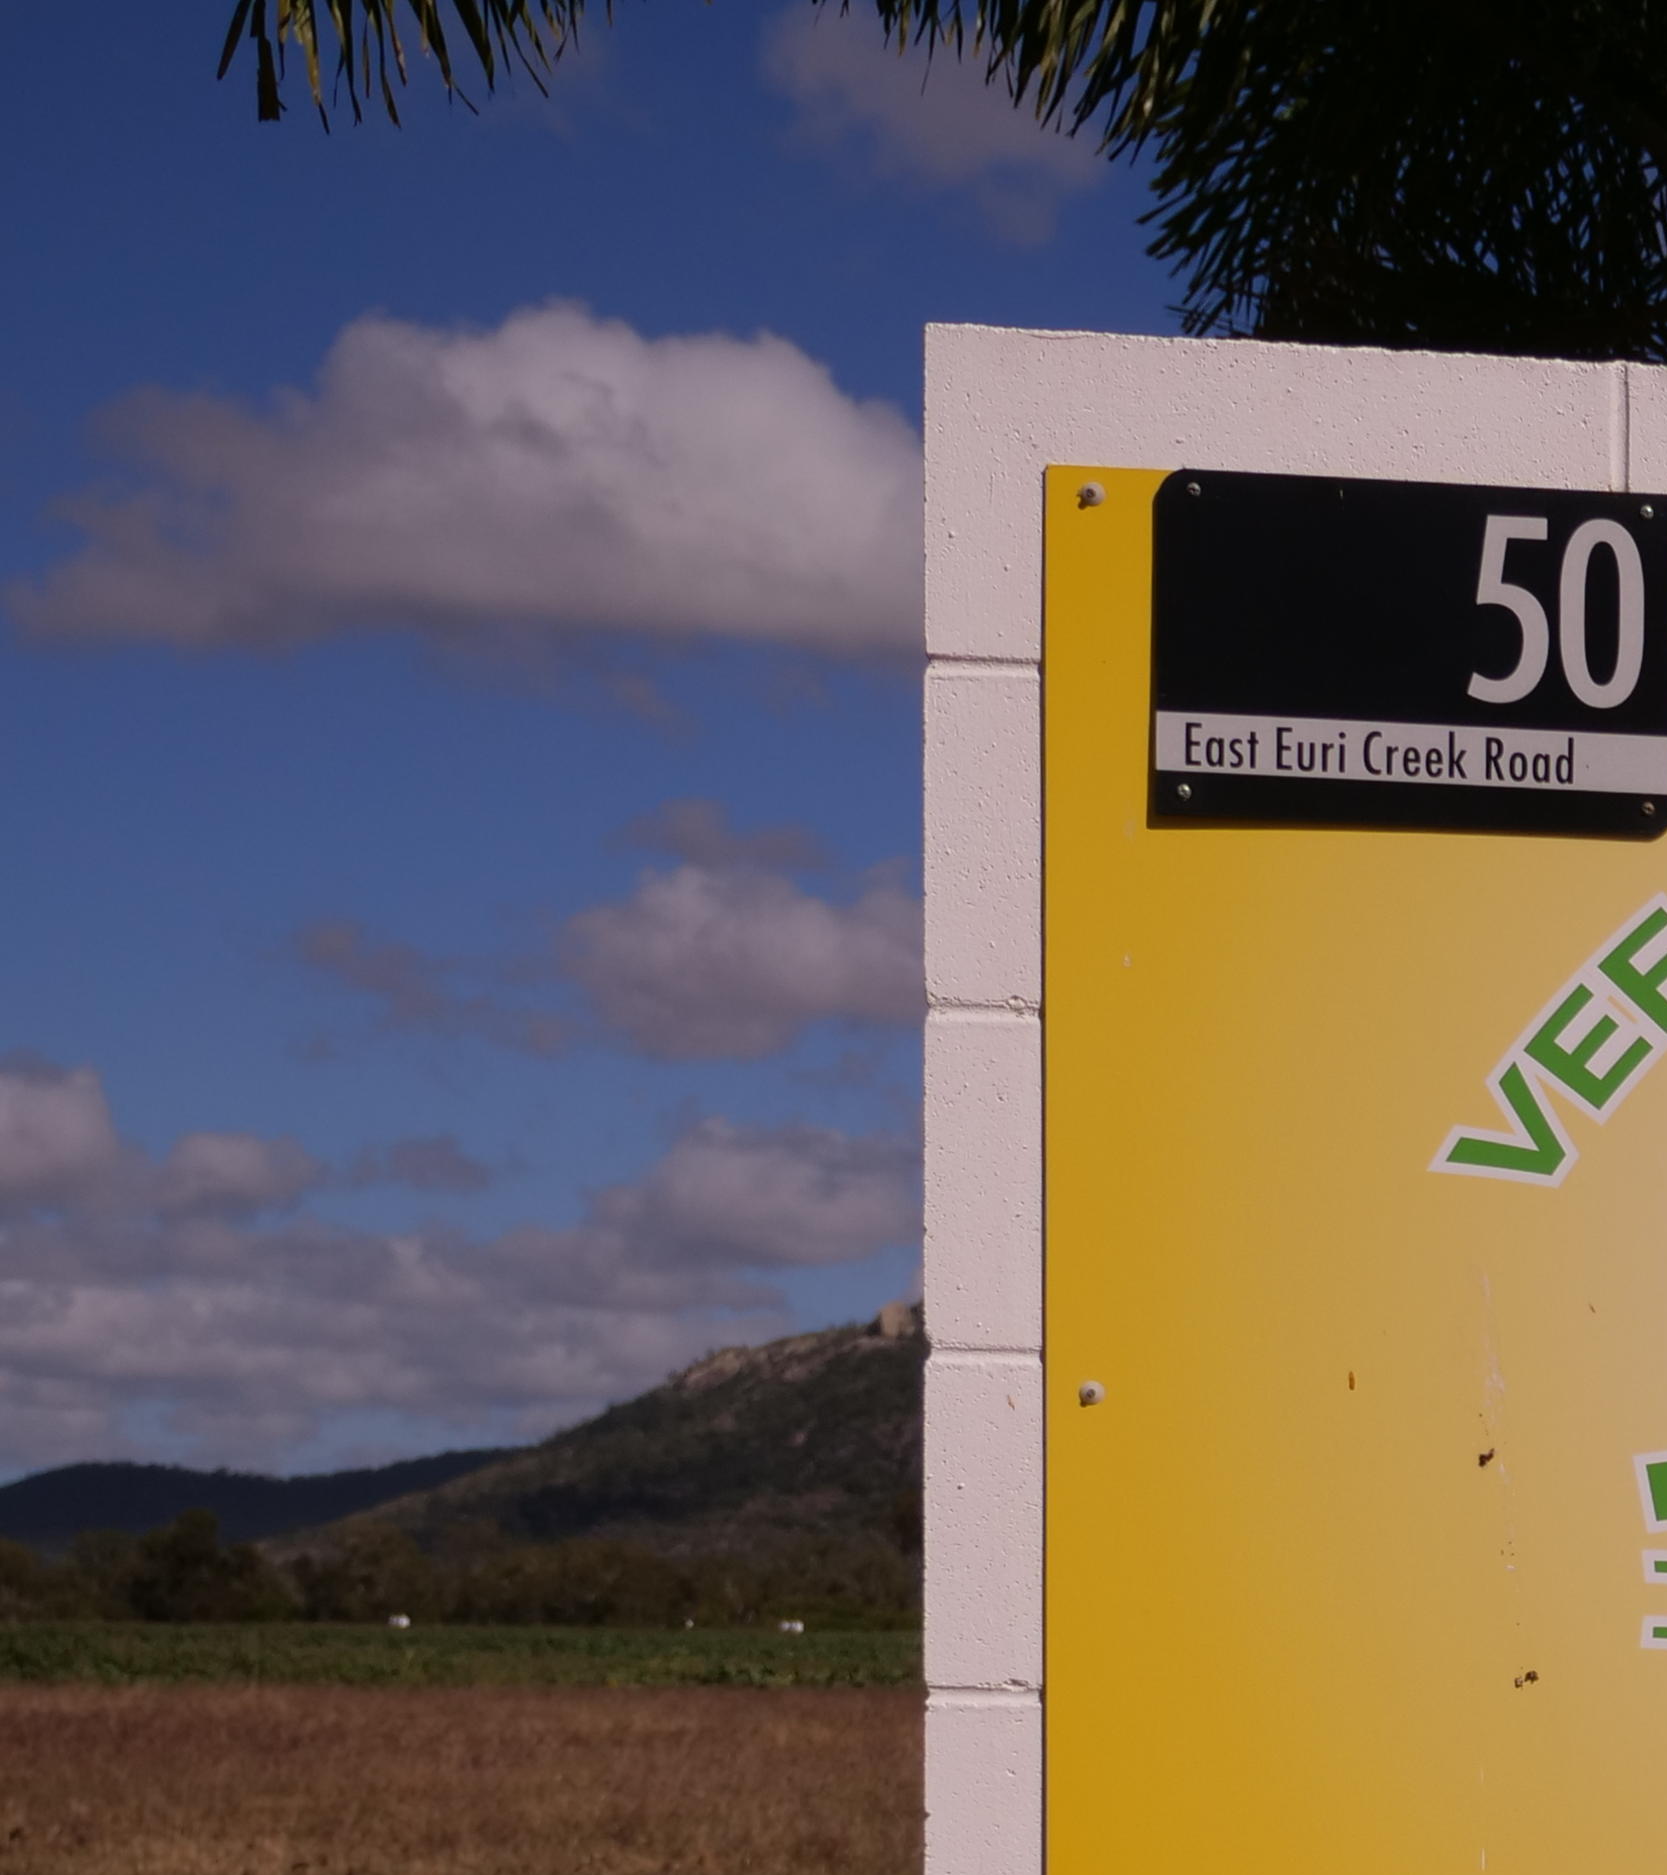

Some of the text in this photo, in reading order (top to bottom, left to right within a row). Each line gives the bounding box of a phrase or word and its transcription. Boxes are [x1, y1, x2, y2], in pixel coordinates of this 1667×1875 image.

[1467, 515, 1645, 708] 50
[1184, 722, 1574, 784] East Euri Creek Road
